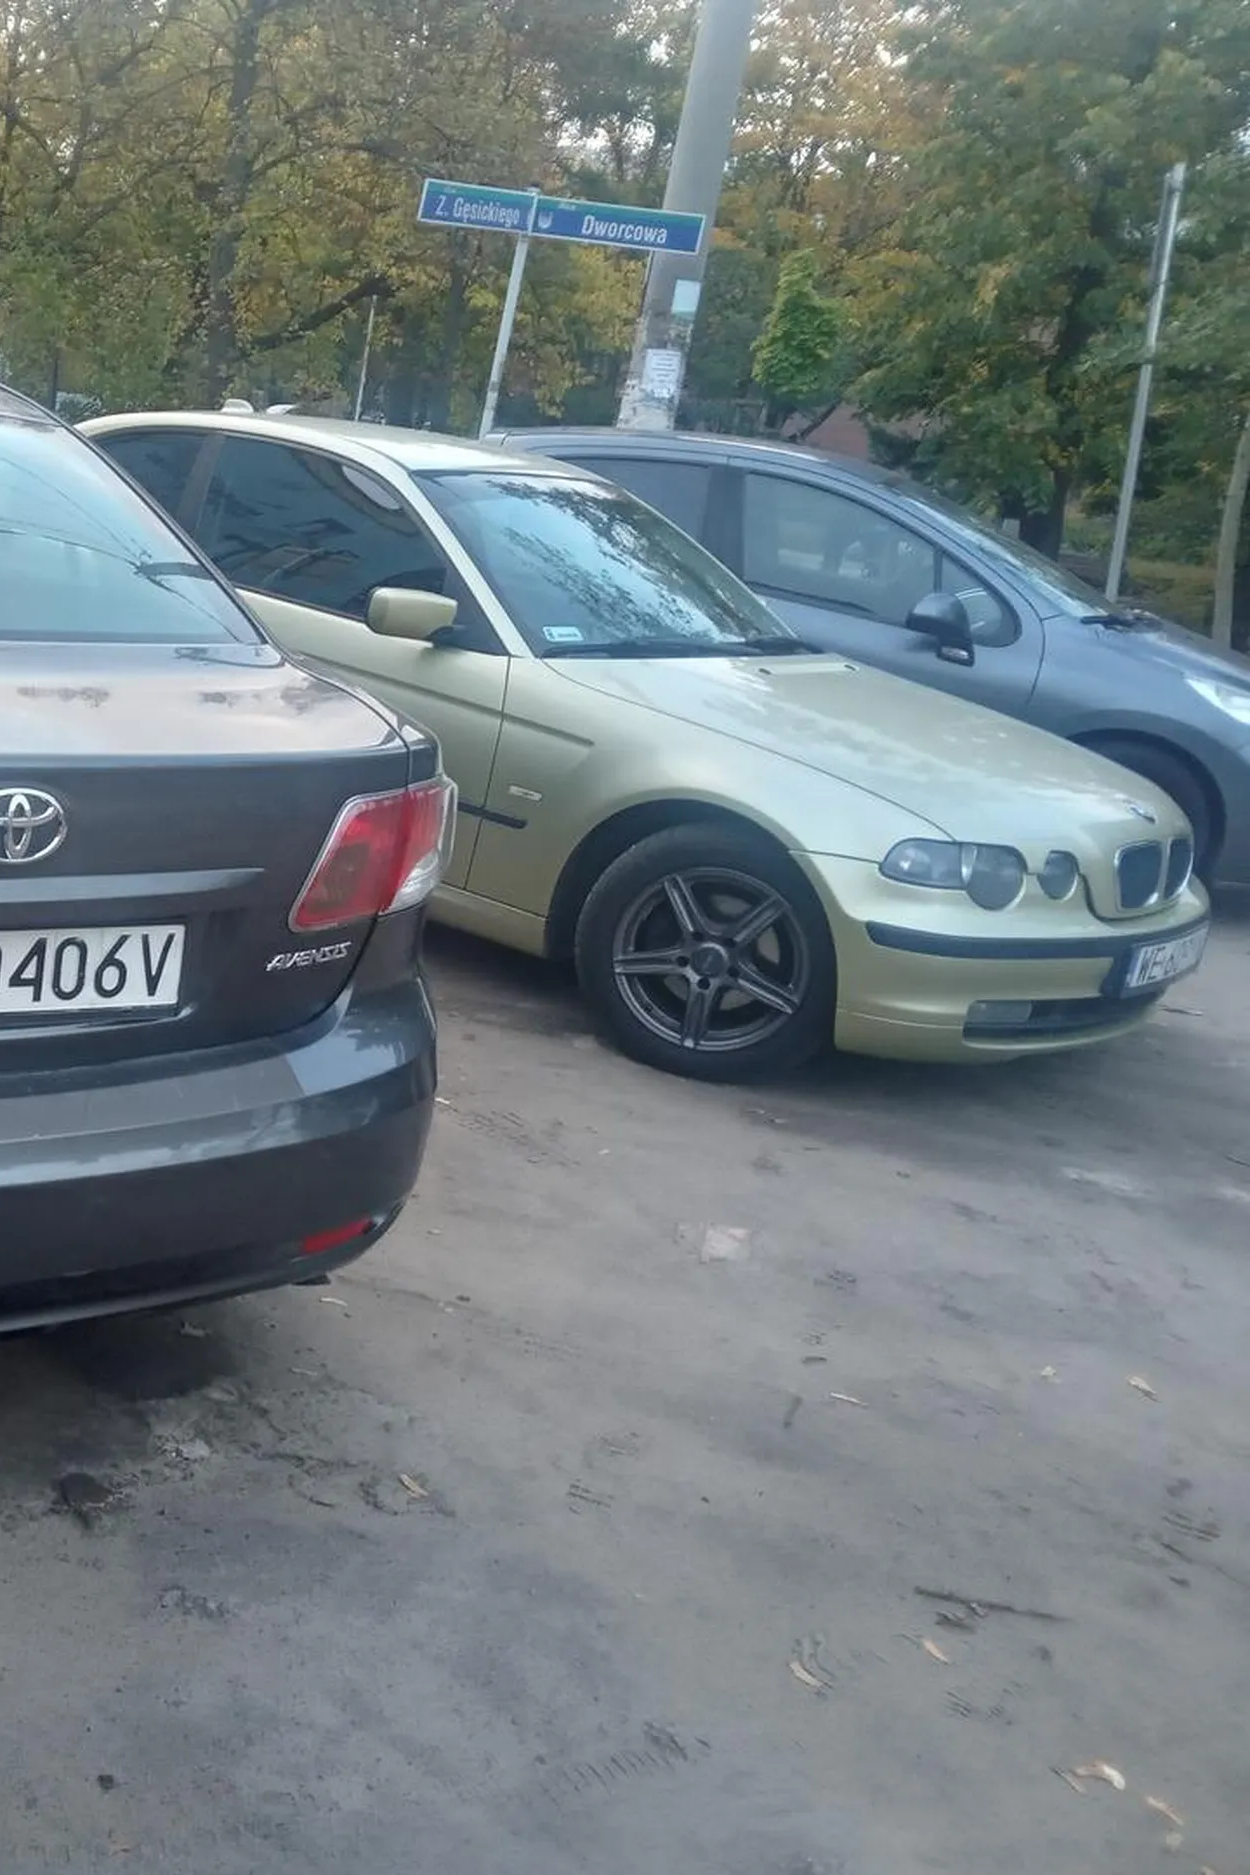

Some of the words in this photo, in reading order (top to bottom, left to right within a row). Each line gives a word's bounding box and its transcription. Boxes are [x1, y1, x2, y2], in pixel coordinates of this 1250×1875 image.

[435, 194, 448, 216] Z.
[453, 197, 520, 228] Gęsickiego
[581, 214, 668, 244] Dworcowa
